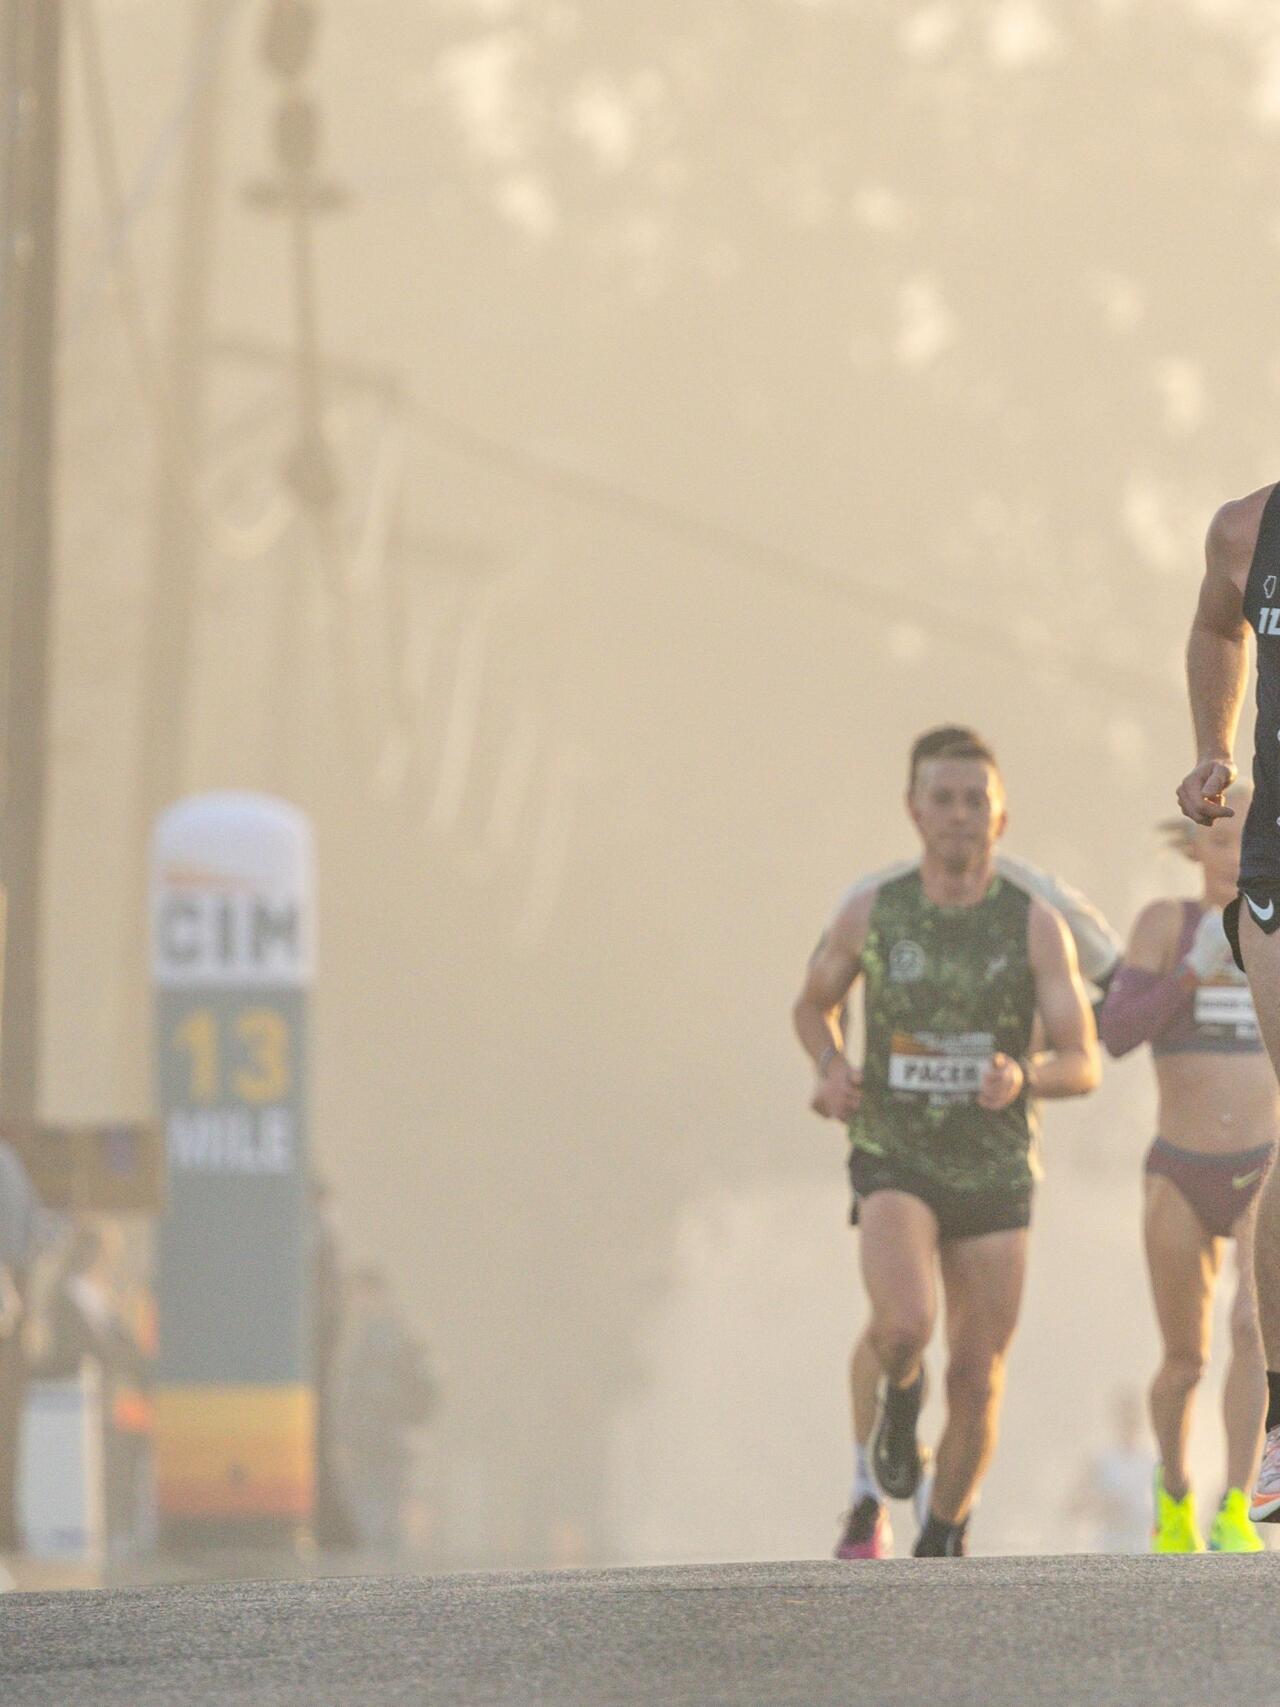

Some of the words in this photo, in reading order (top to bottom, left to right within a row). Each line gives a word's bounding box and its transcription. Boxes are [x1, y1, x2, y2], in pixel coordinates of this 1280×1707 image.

[160, 894, 300, 966] CIM
[174, 1008, 290, 1102] 13
[167, 1109, 290, 1174] MILE
